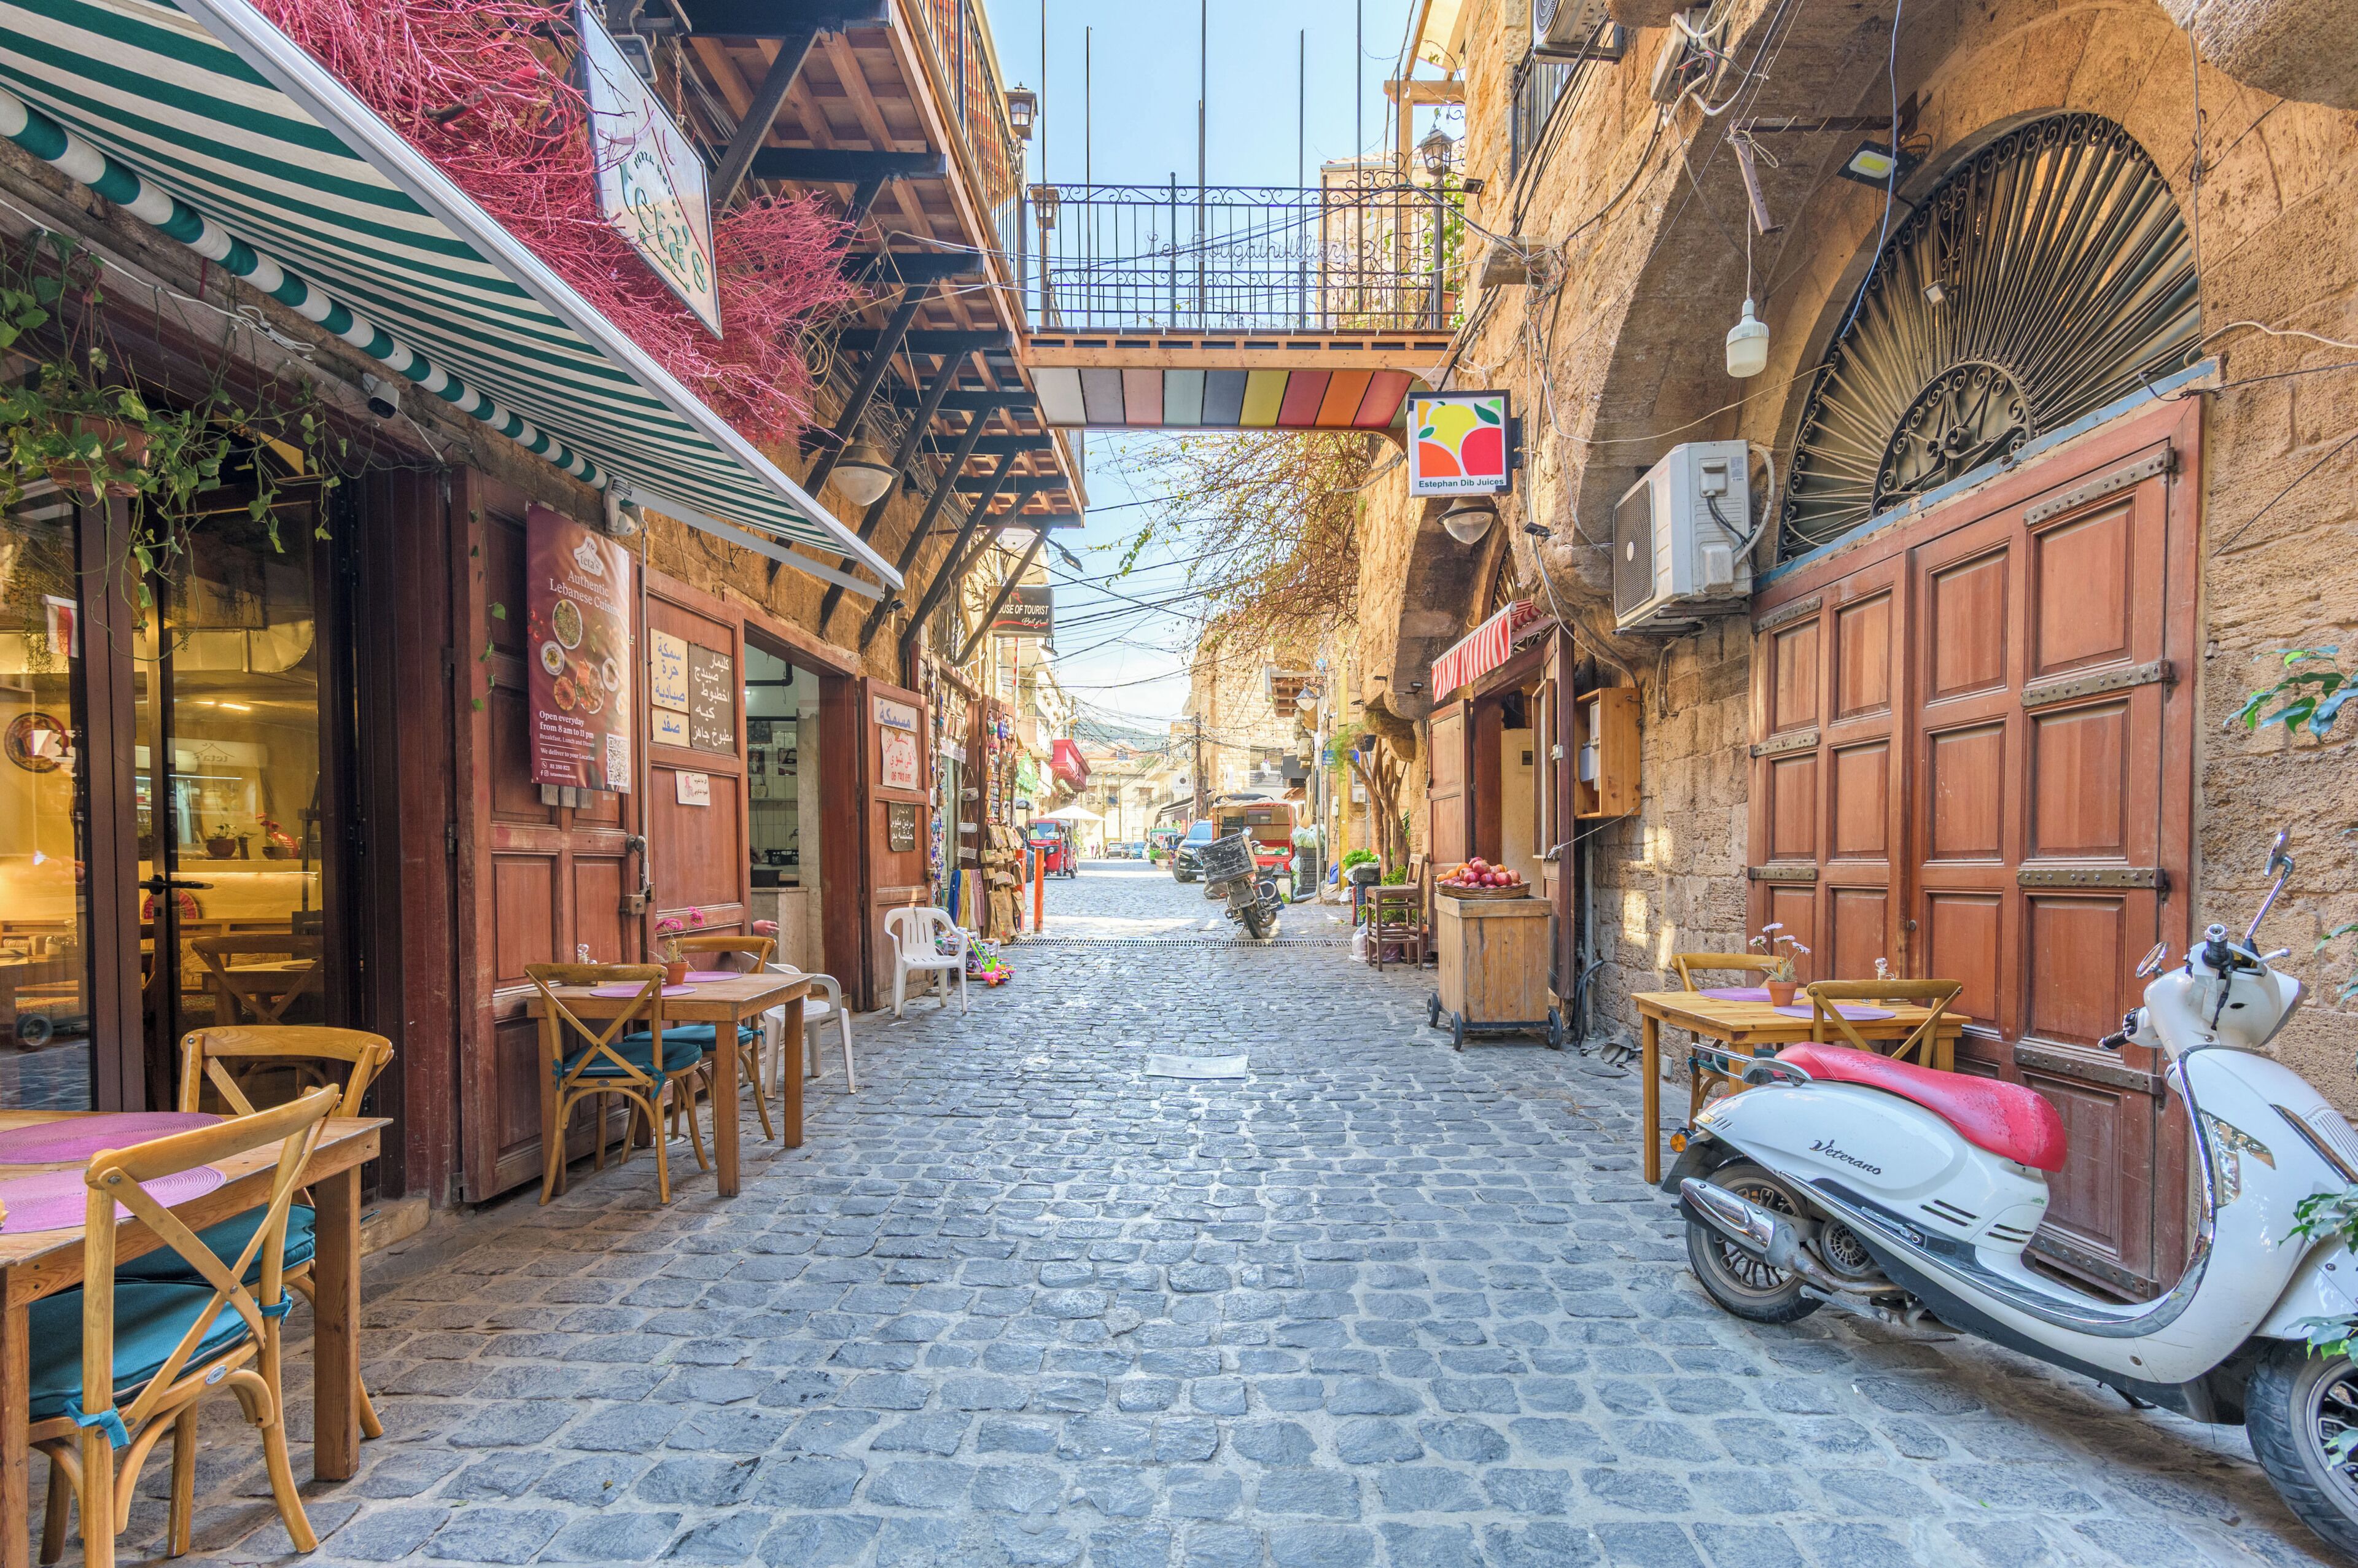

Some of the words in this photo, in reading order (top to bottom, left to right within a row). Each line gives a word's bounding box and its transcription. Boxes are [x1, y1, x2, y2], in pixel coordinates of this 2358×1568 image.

[1147, 233, 1185, 257] Les
[1419, 480, 1458, 489] Estephan
[550, 578, 593, 605] Lebanese
[567, 570, 609, 597] Authentic
[1014, 604, 1024, 615] OF
[1024, 605, 1049, 615] TOURIST
[658, 636, 682, 661] سمكة
[661, 659, 679, 680] حرة
[655, 677, 685, 705] صيادية
[539, 710, 558, 721] Open
[558, 716, 585, 727] everyday
[879, 700, 911, 729] مسمكة
[539, 721, 557, 732] from
[692, 725, 710, 742] جاهز
[711, 726, 733, 747] مطبوخ
[539, 733, 562, 742] Breakfast,
[891, 771, 897, 781] 06
[1809, 1139, 1881, 1174] Veterano
